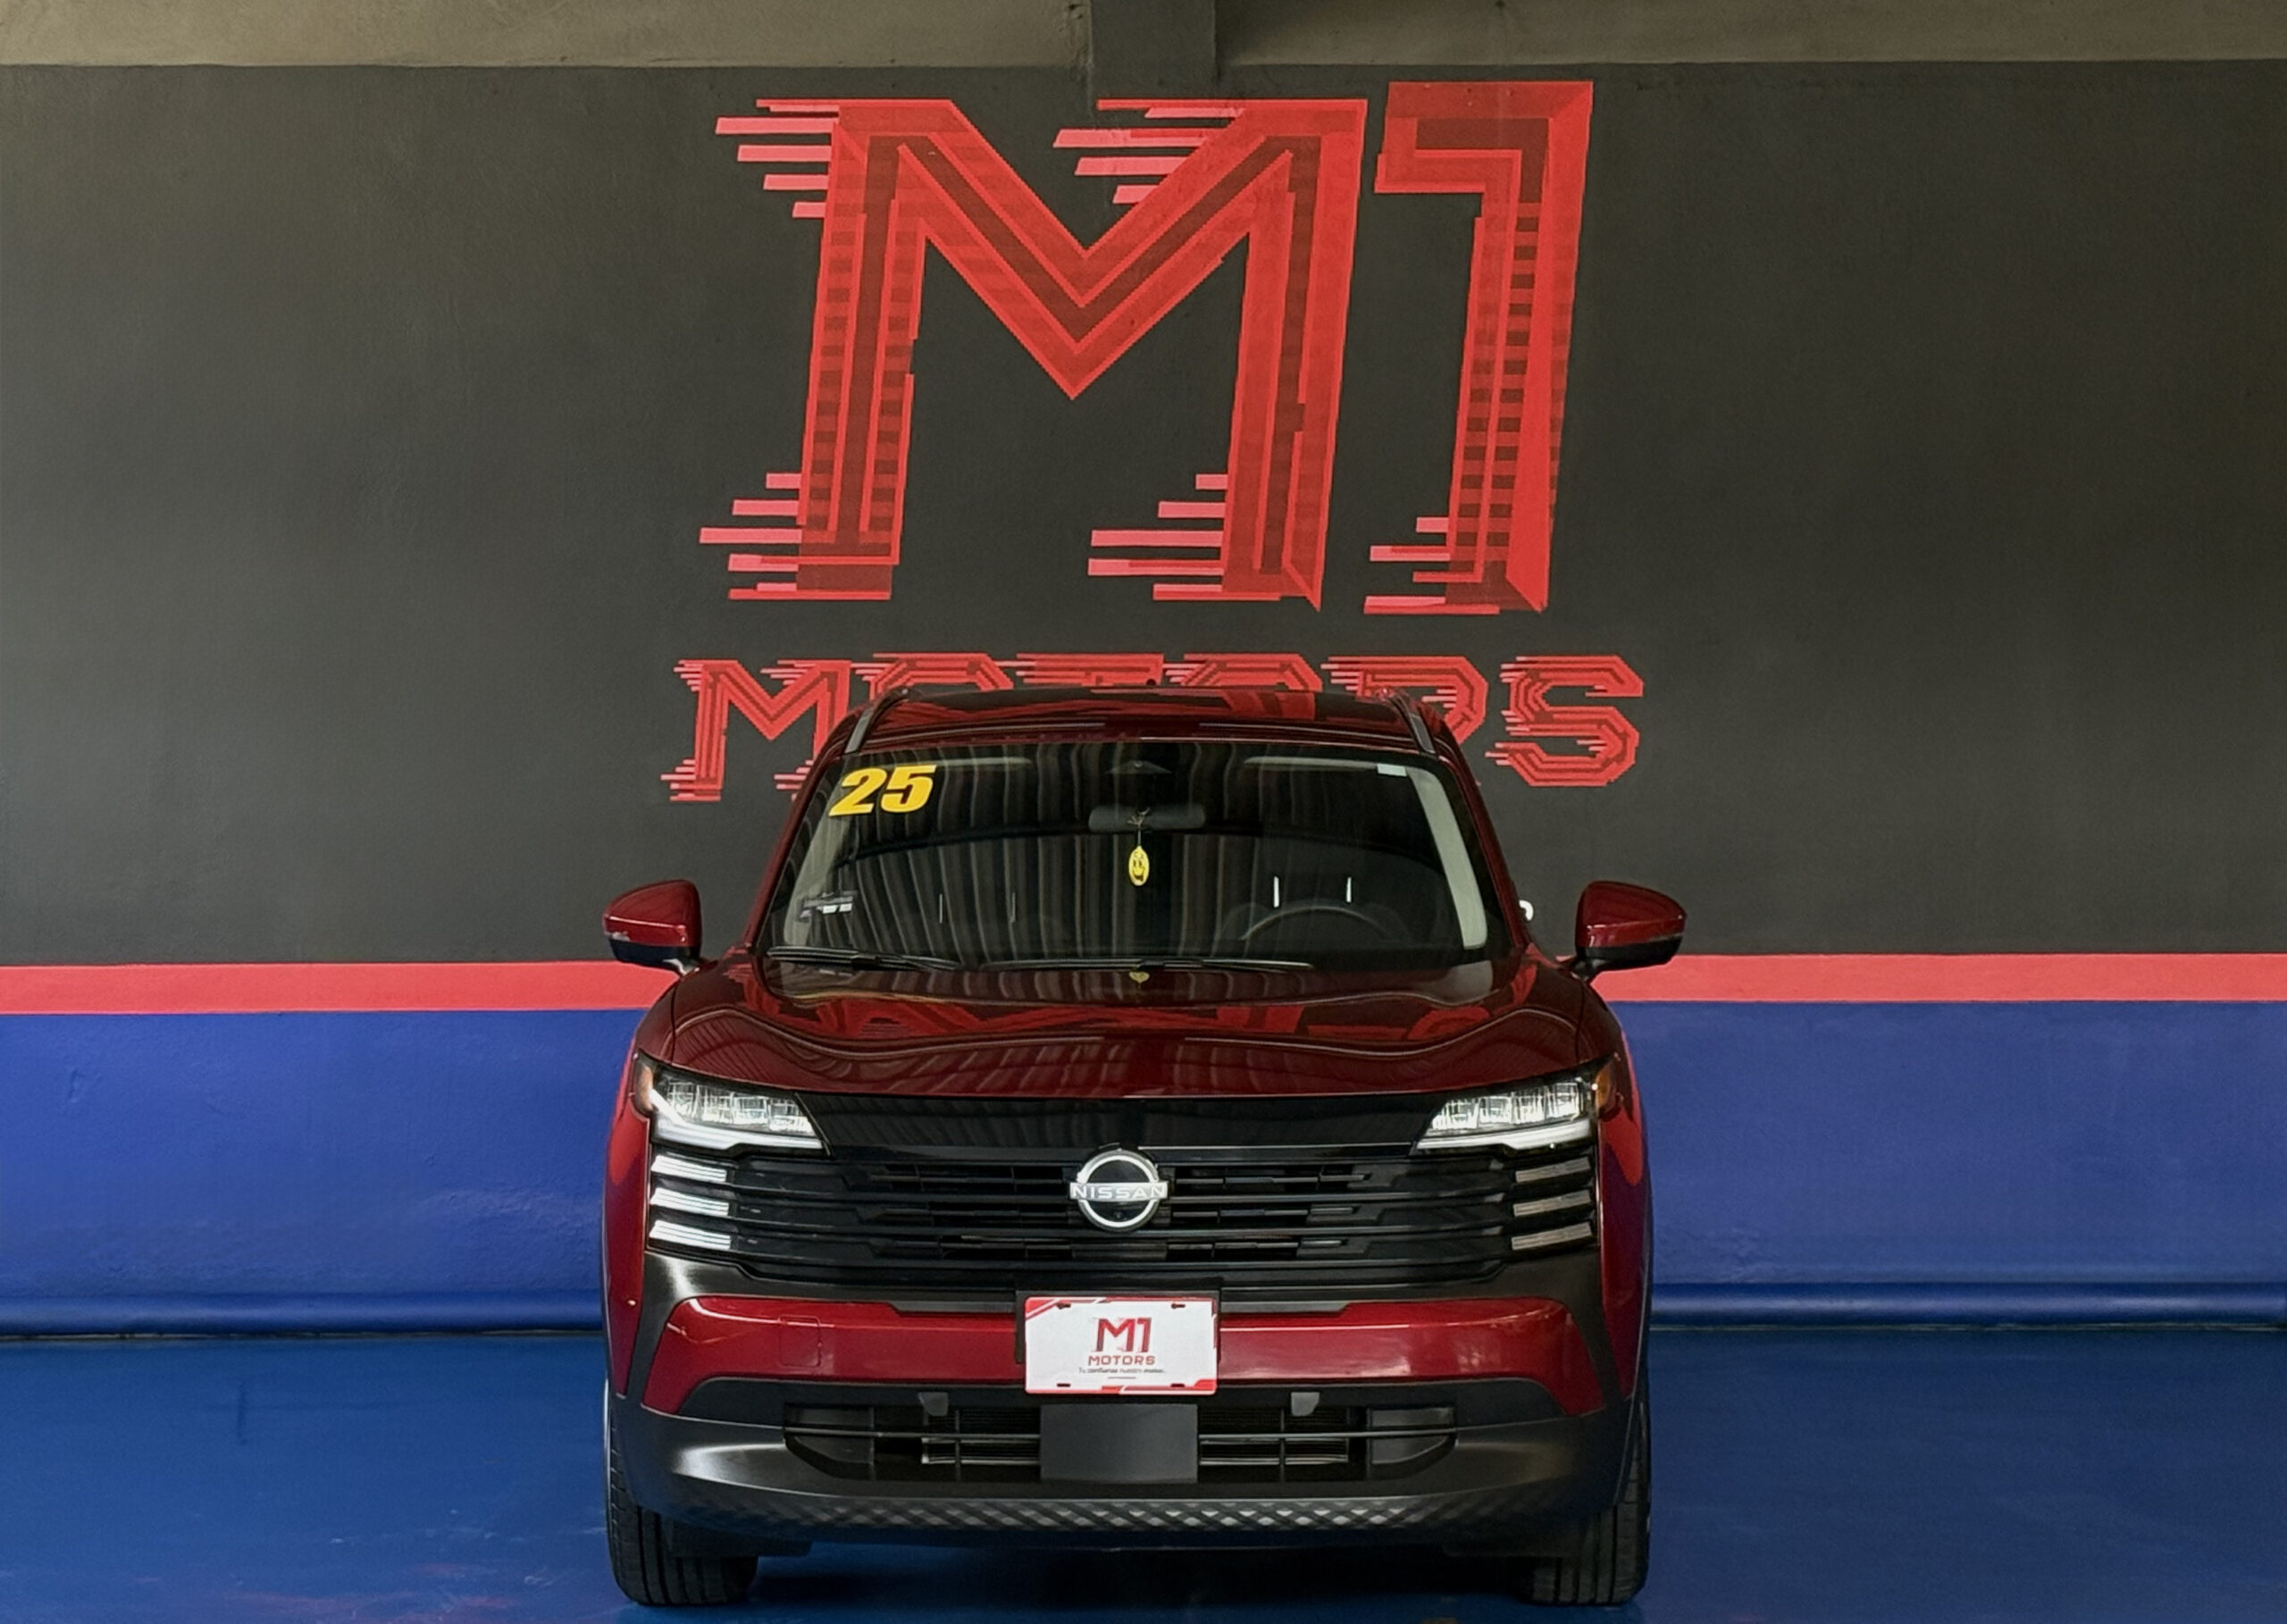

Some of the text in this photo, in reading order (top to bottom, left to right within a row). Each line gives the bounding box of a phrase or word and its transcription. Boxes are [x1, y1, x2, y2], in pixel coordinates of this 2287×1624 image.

[700, 80, 1594, 614] M1
[829, 765, 937, 817] 25
[1072, 1185, 1165, 1200] NISSAN
[1092, 1317, 1152, 1352] M1
[1088, 1355, 1156, 1366] MOTORS
